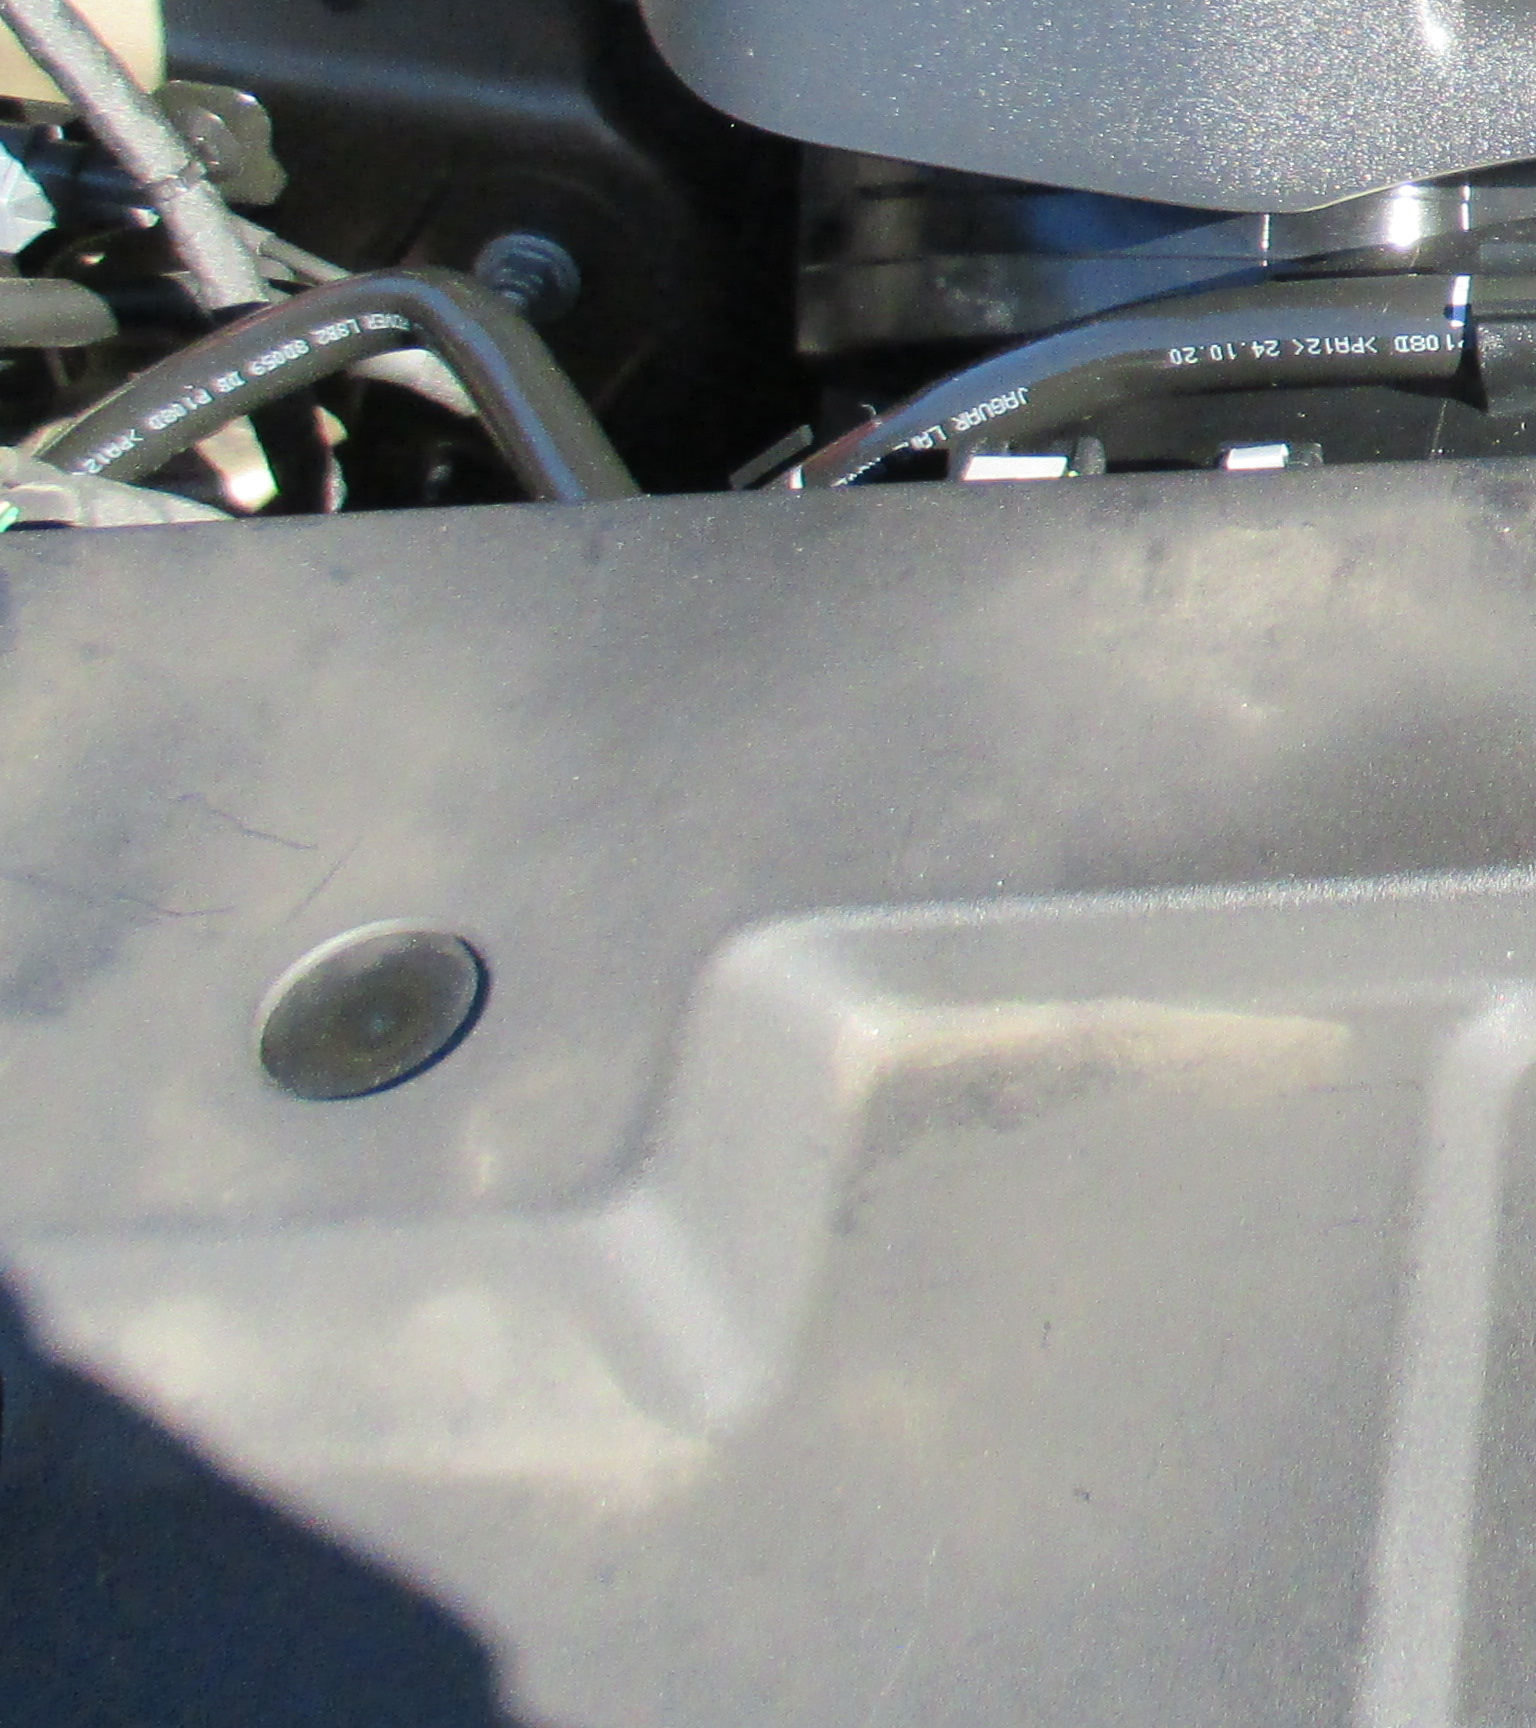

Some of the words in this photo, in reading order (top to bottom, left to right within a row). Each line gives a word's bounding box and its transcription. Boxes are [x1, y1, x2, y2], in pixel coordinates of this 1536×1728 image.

[1168, 338, 1281, 366] 24.10.20
[1291, 334, 1379, 357] >PA12<
[1393, 333, 1464, 354] 108D
[950, 386, 1030, 433] JAGUAR
